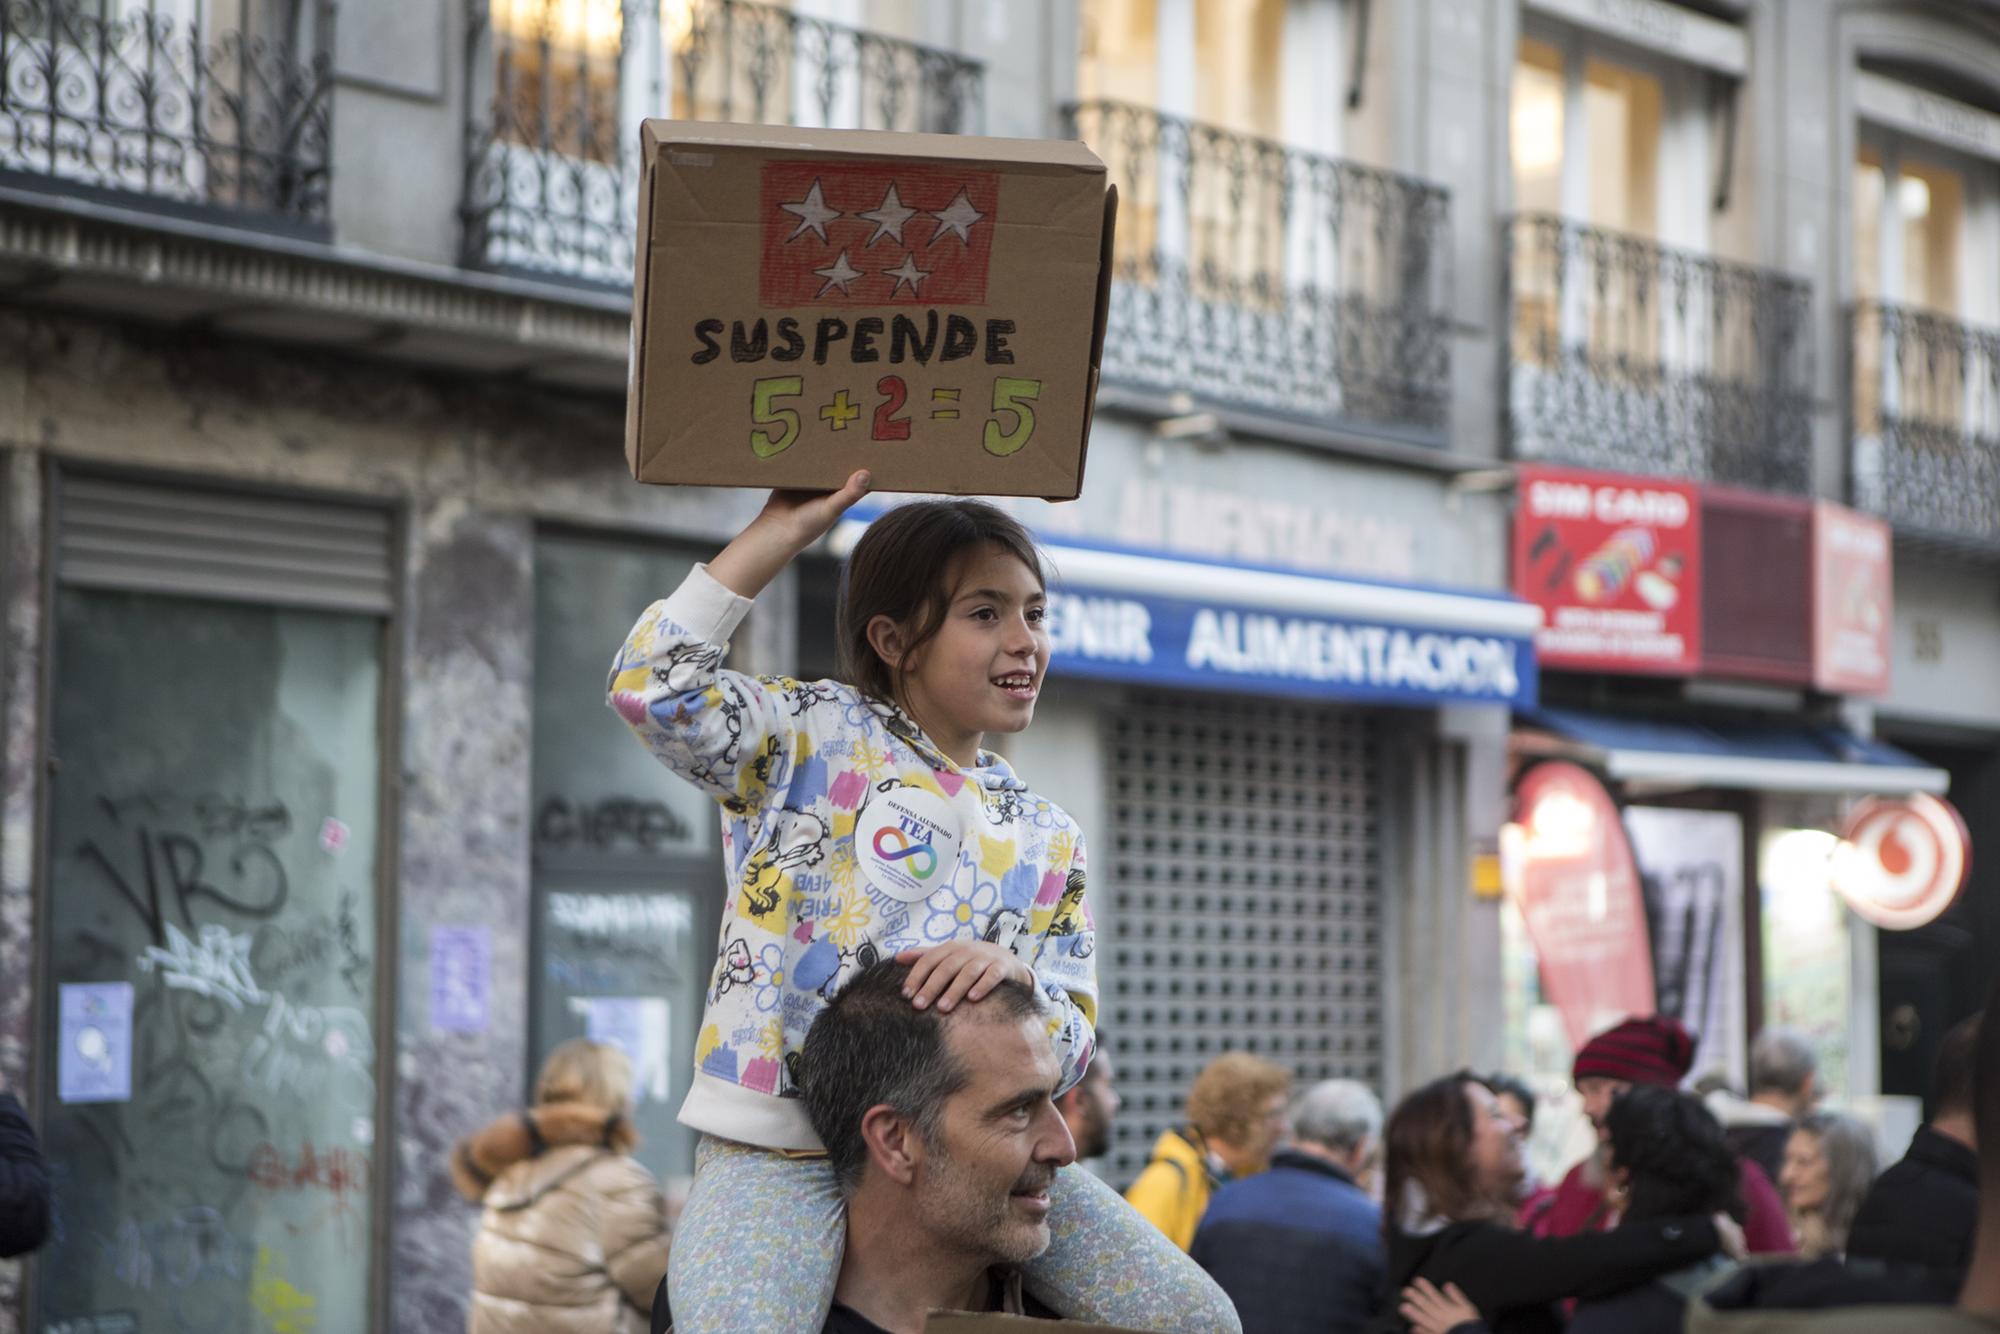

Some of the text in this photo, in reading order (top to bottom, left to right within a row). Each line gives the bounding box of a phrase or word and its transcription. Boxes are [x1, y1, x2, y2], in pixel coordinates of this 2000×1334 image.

[691, 310, 1016, 367] SUSPENDE
[750, 375, 804, 461] 5
[871, 375, 911, 441] 2
[982, 376, 1043, 458] 5
[887, 800, 953, 840] DEFENSA ALUMNADO
[899, 815, 933, 846] TEA
